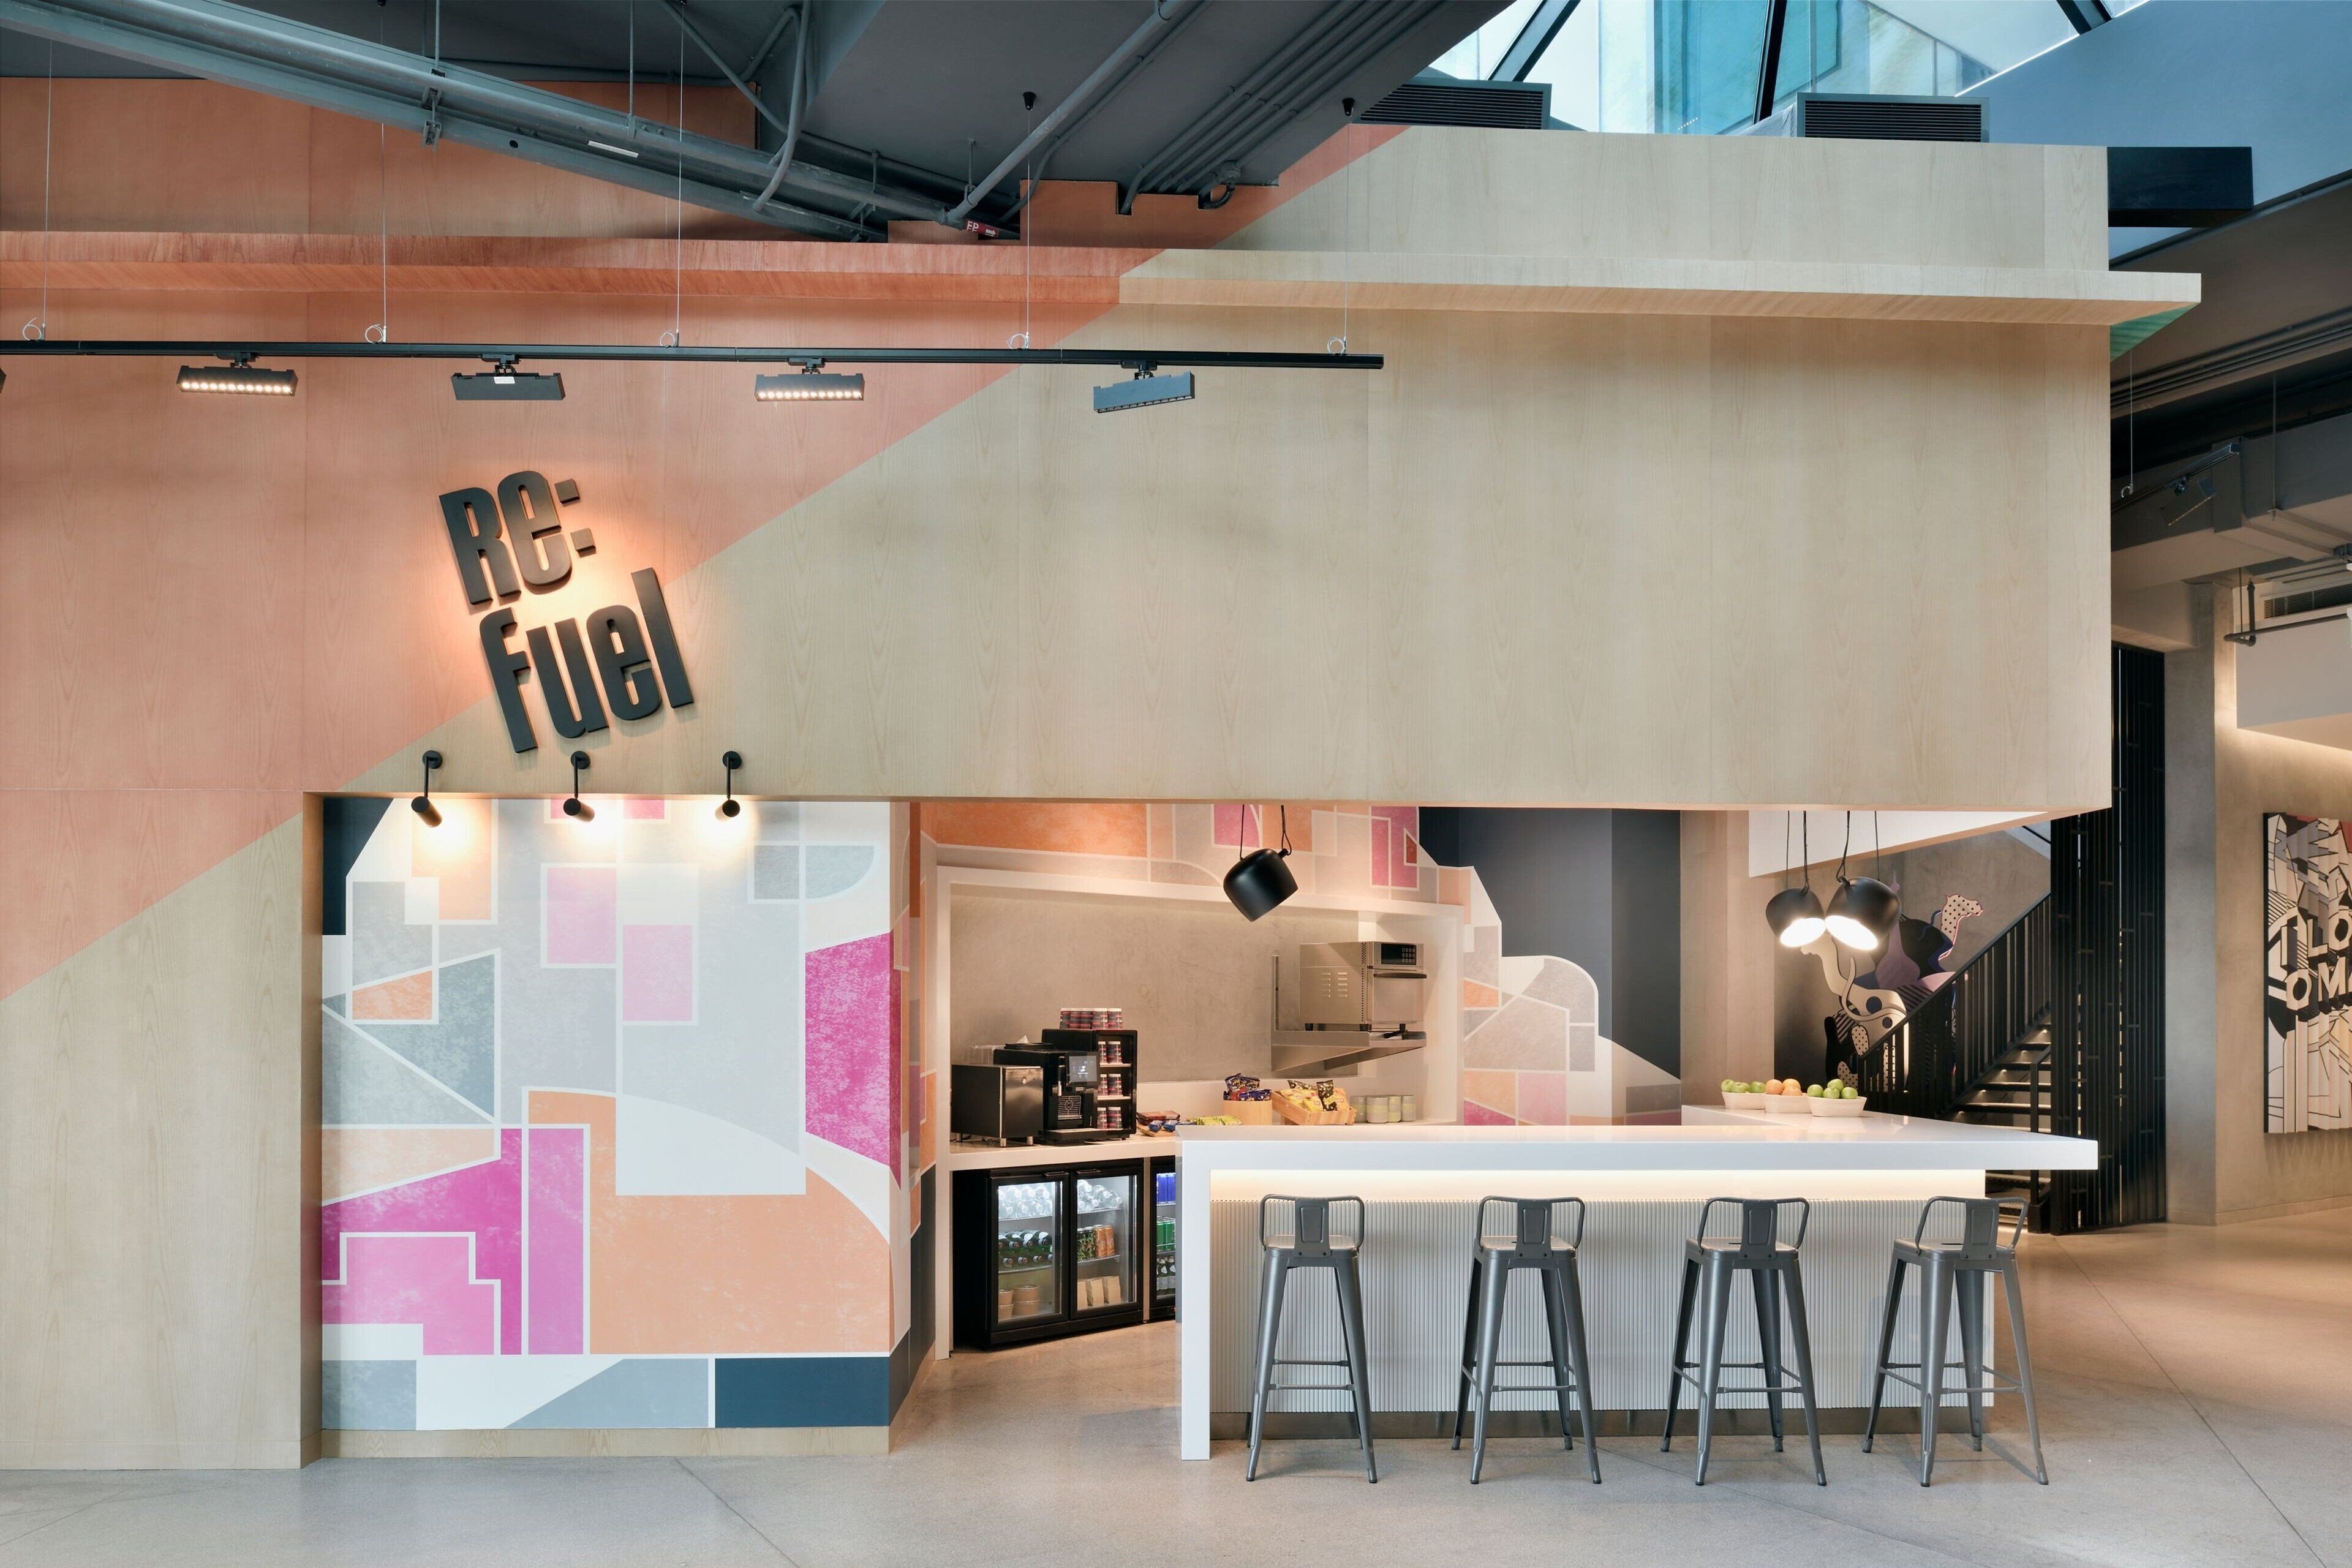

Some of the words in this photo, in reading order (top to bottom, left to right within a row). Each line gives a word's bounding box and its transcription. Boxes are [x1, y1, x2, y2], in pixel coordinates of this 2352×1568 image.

[439, 470, 596, 605] Re:
[479, 567, 694, 753] fuel
[2286, 956, 2352, 1011] OM
